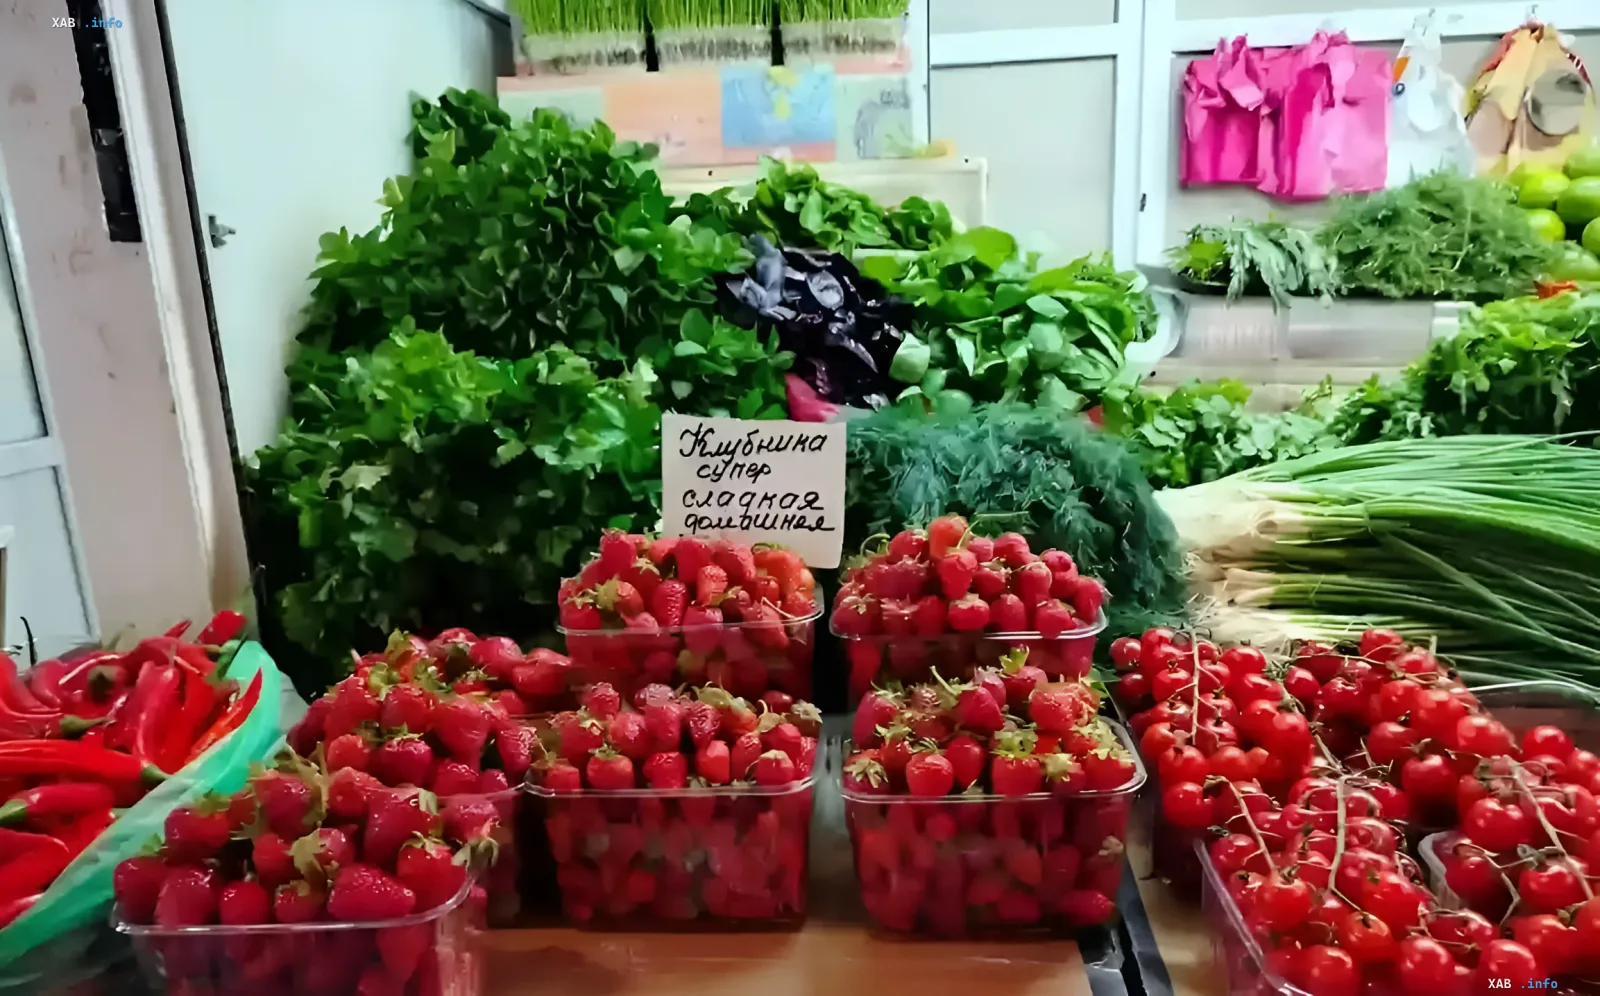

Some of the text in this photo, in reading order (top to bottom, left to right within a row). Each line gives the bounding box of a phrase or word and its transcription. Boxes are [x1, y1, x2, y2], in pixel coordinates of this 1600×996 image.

[679, 422, 828, 459] Клубника
[696, 458, 772, 484] супер
[682, 488, 825, 515] сладкая
